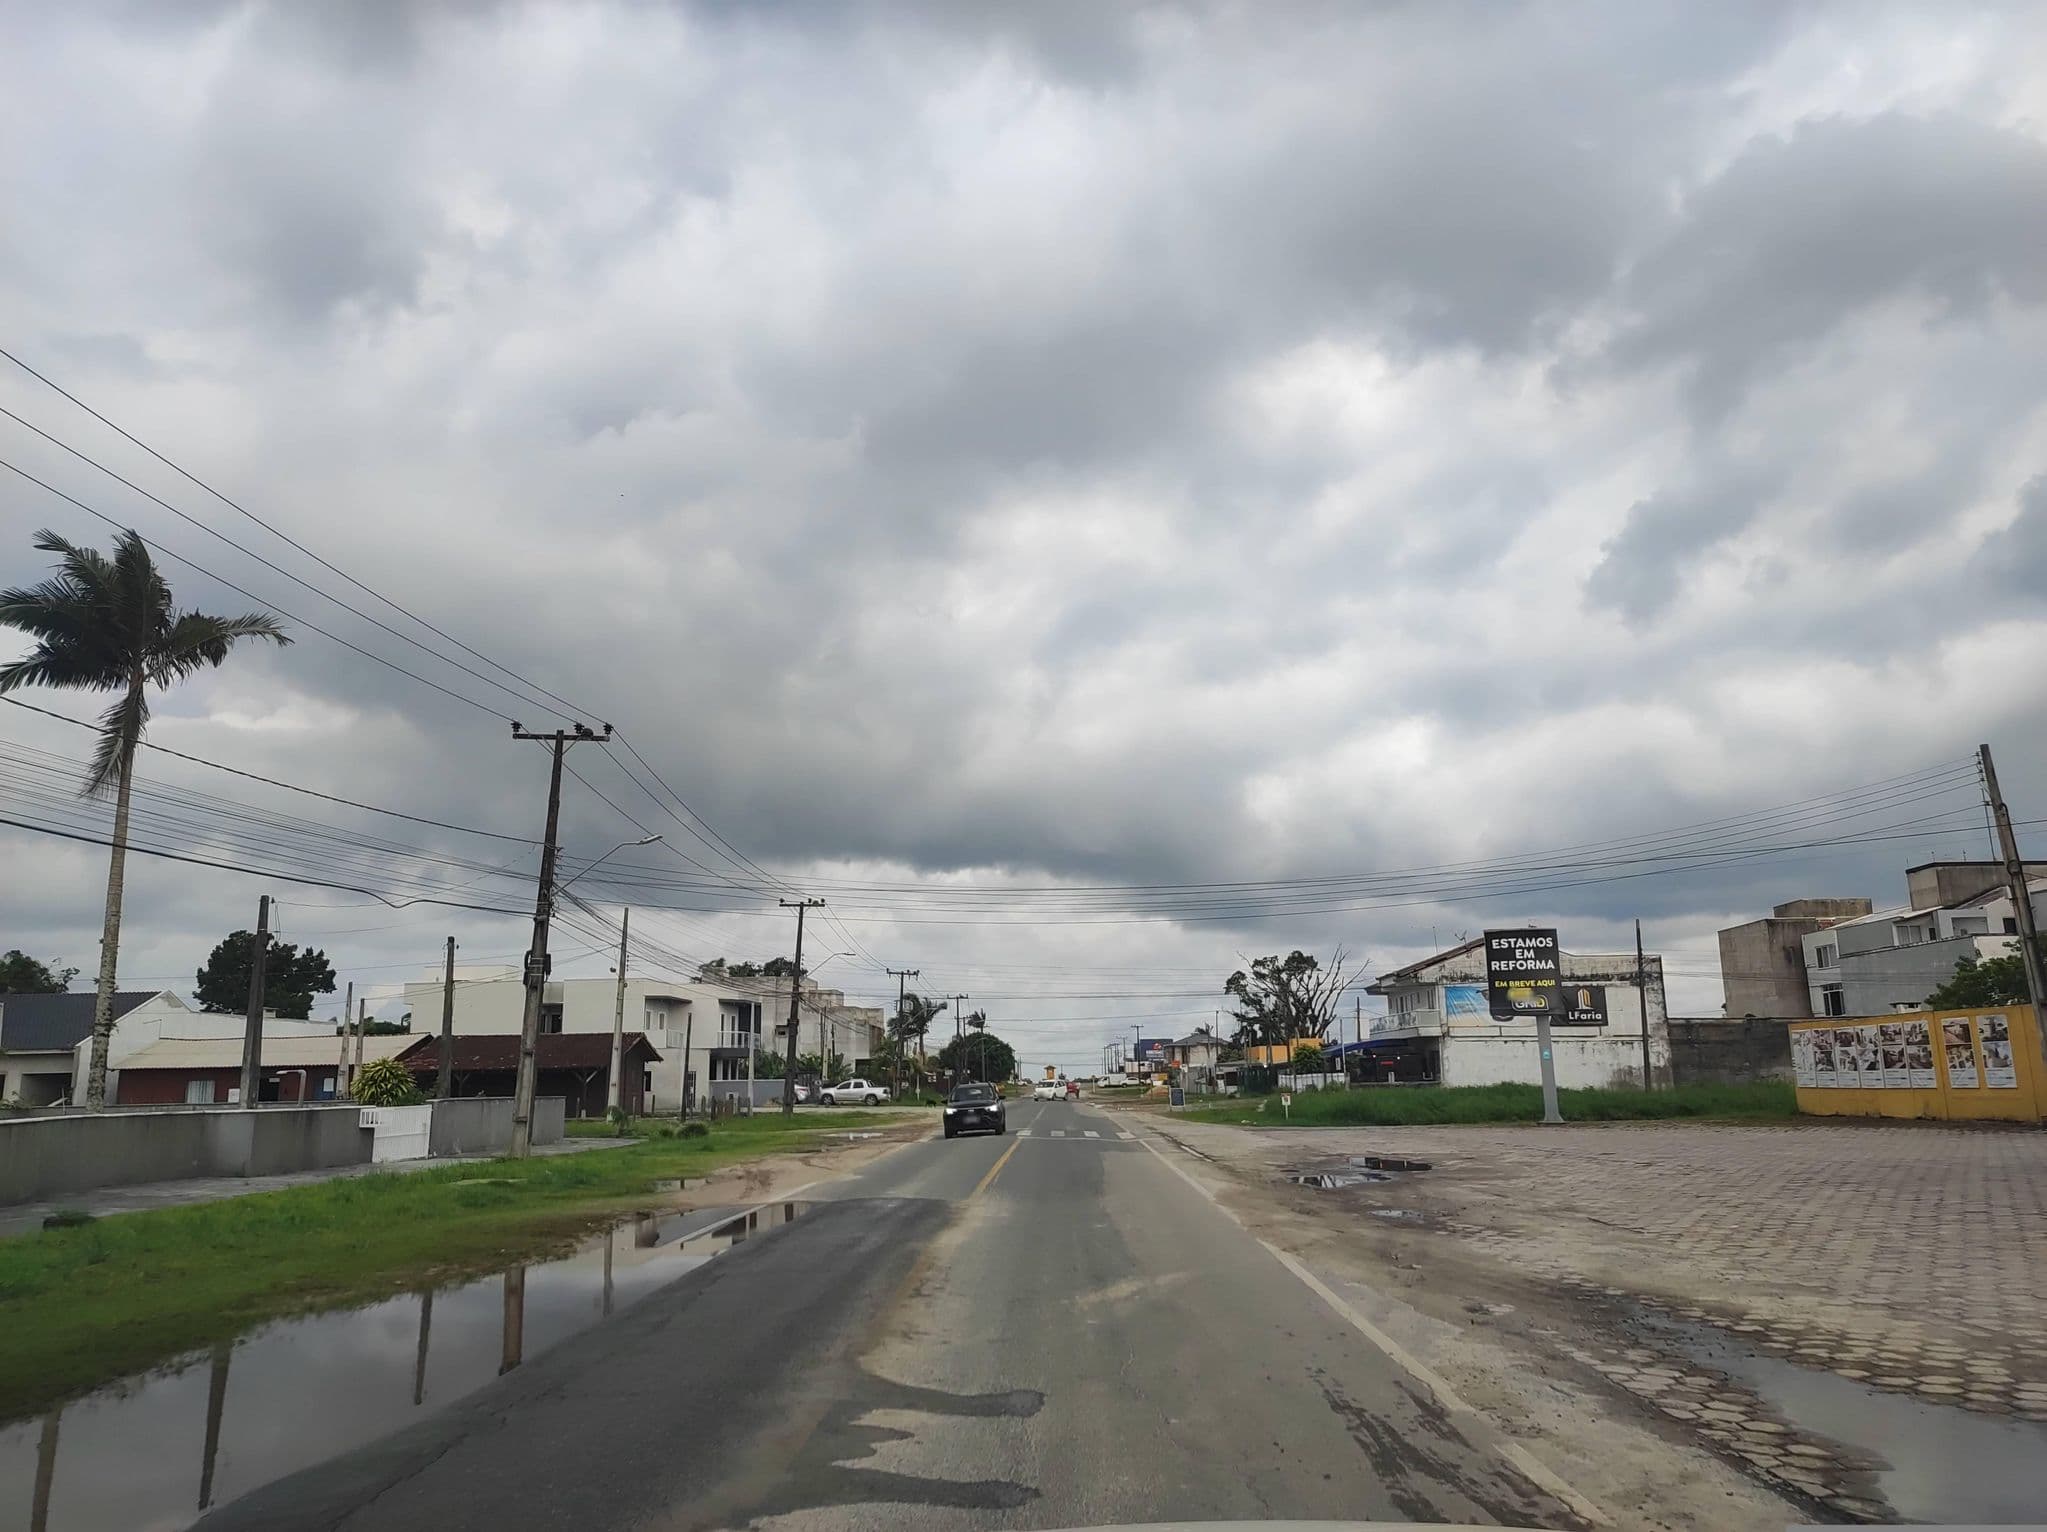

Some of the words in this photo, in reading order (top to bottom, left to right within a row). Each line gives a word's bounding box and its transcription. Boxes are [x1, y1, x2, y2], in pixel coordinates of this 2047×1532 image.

[1492, 938, 1553, 949] ESTAMOS
[1515, 949, 1535, 959] EM
[1491, 960, 1555, 971] REFORMA
[1495, 980, 1508, 988] EM
[1509, 980, 1536, 988] BREVE
[1537, 979, 1556, 987] AQUI
